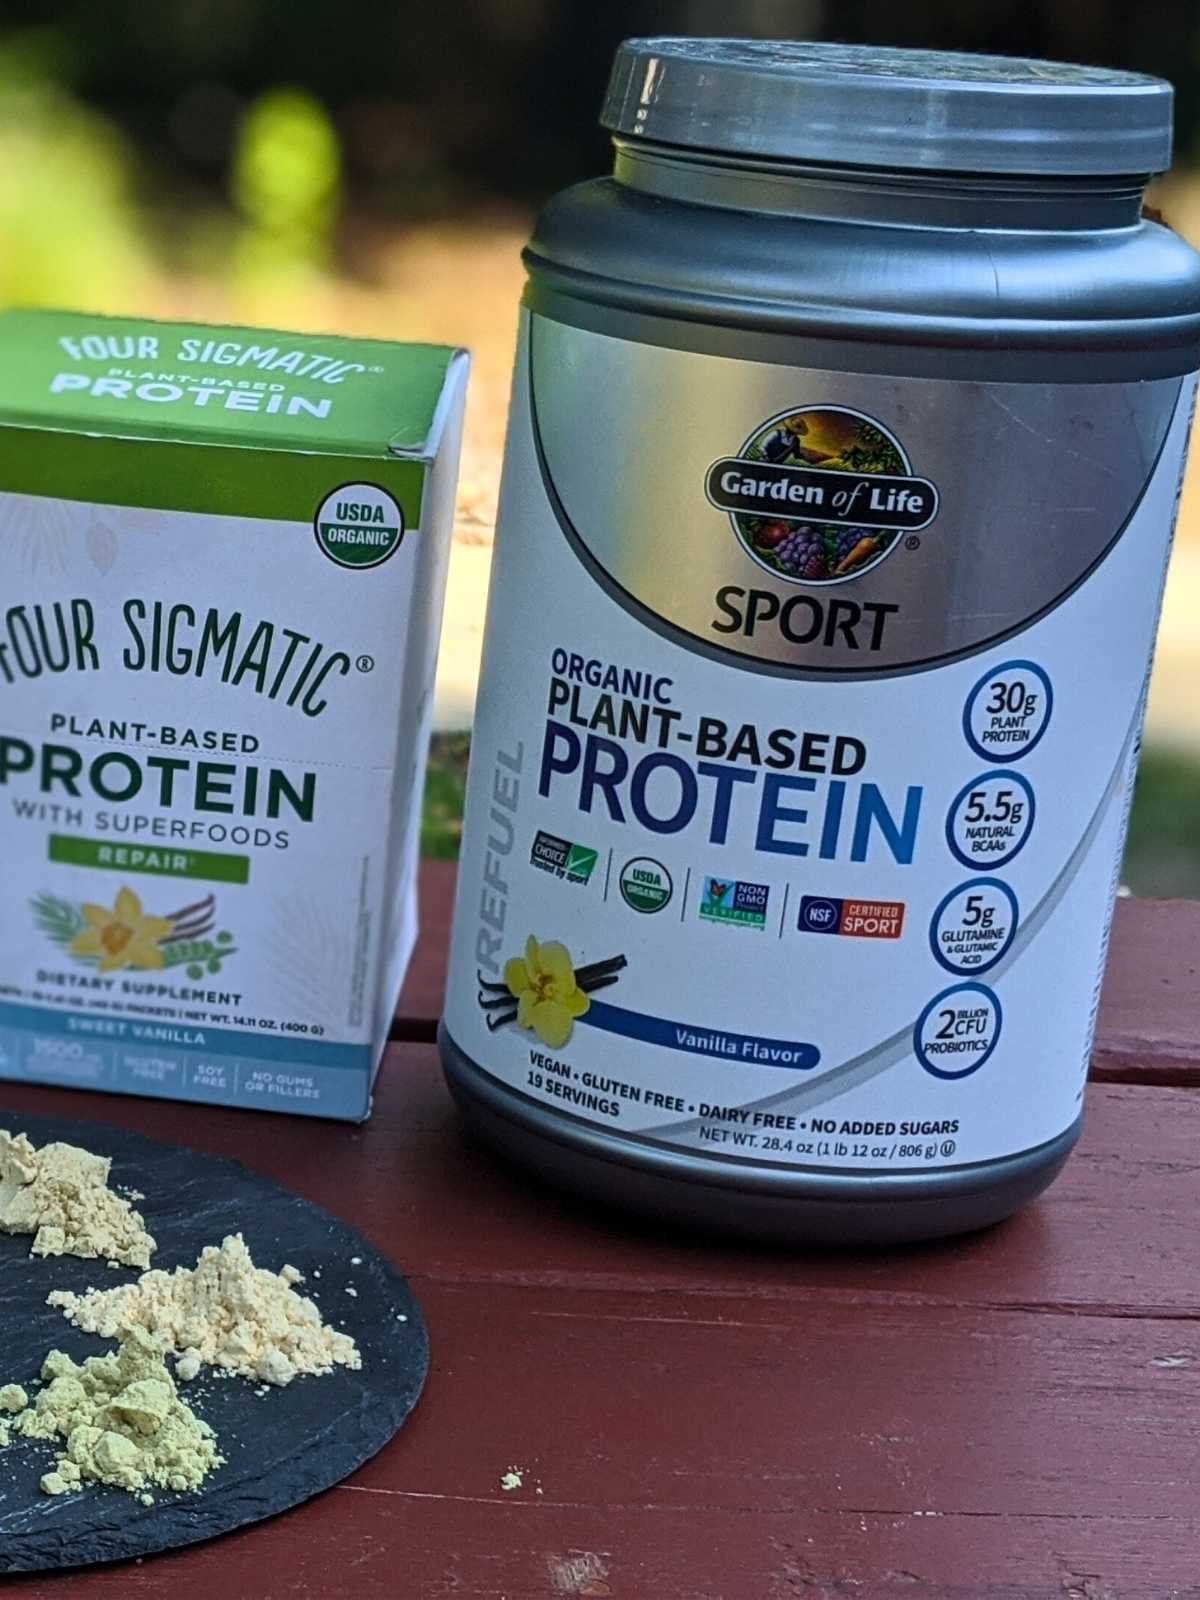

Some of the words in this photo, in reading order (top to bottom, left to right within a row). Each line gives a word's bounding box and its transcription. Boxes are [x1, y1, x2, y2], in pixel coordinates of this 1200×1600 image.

[58, 336, 159, 361] FOUR
[177, 339, 366, 384] SIGMATIC
[108, 367, 287, 392] PLANT-BASED
[49, 373, 332, 419] PROTEIN
[718, 470, 825, 507] Garden
[830, 480, 871, 517] of
[869, 487, 925, 516] Life
[335, 501, 386, 524] USDA
[327, 525, 390, 548] ORGANIC
[710, 584, 901, 652] SPORT
[122, 599, 352, 718] SIGMATIC
[550, 646, 675, 706] ORGANIC
[985, 681, 1039, 717] 30g
[50, 712, 260, 754] PLANT-BASED
[547, 676, 869, 778] PLANT-BASED
[990, 716, 1027, 730] PLANT
[982, 729, 1031, 744] PROTEIN
[538, 718, 925, 867] PROTEIN
[964, 790, 1025, 825] 5.5g
[11, 799, 84, 828] WITH
[94, 811, 290, 850] SUPERFOODS
[965, 826, 1016, 840] NATURAL
[98, 846, 189, 871] REPAIR
[475, 740, 525, 976] REFUEL
[534, 844, 566, 865] CHOICE
[971, 840, 1007, 853] BCAAs
[632, 868, 663, 887] USDA
[737, 883, 768, 897] NON
[736, 892, 767, 906] GMO
[848, 904, 899, 919] CERTIFIED
[809, 908, 833, 923] NSF
[962, 896, 995, 929] 5g
[843, 916, 900, 935] SPORT
[941, 928, 1006, 943] GLUTAMINE
[954, 942, 1000, 954] GLUTAMIC
[960, 954, 982, 965] ACID
[35, 968, 115, 993] DIETARY
[121, 980, 243, 1008] SUPPLEMENT
[131, 1023, 207, 1046] VANILLA
[935, 1008, 957, 1040] 2
[954, 1018, 988, 1037] CFU
[675, 1029, 738, 1055] Vanilla
[743, 1041, 804, 1065] Flavor
[924, 1038, 989, 1055] PROBIOTICS
[252, 1070, 273, 1084] NO
[275, 1073, 314, 1088] GUMS
[268, 1084, 321, 1100] FILLERS
[527, 1069, 544, 1089] 19
[544, 1077, 621, 1118] SERVINGS
[529, 1050, 571, 1080] VEGAN
[581, 1072, 642, 1103] GLUTEN
[644, 1091, 686, 1114] FREE
[699, 1102, 751, 1125] DAIRY
[753, 1112, 797, 1132] FREE
[811, 1118, 837, 1135] NO
[839, 1120, 897, 1137] ADDED
[899, 1119, 960, 1137] SUGARS
[699, 1125, 731, 1143] NET
[732, 1130, 758, 1149] WT.
[761, 1136, 793, 1154] 28.4
[796, 1142, 813, 1154] oz
[817, 1141, 832, 1158] (1
[834, 1142, 849, 1157] lb
[852, 1143, 868, 1158] 12
[871, 1145, 888, 1158] oz
[898, 1142, 924, 1158] 806
[925, 1142, 939, 1160] g)
